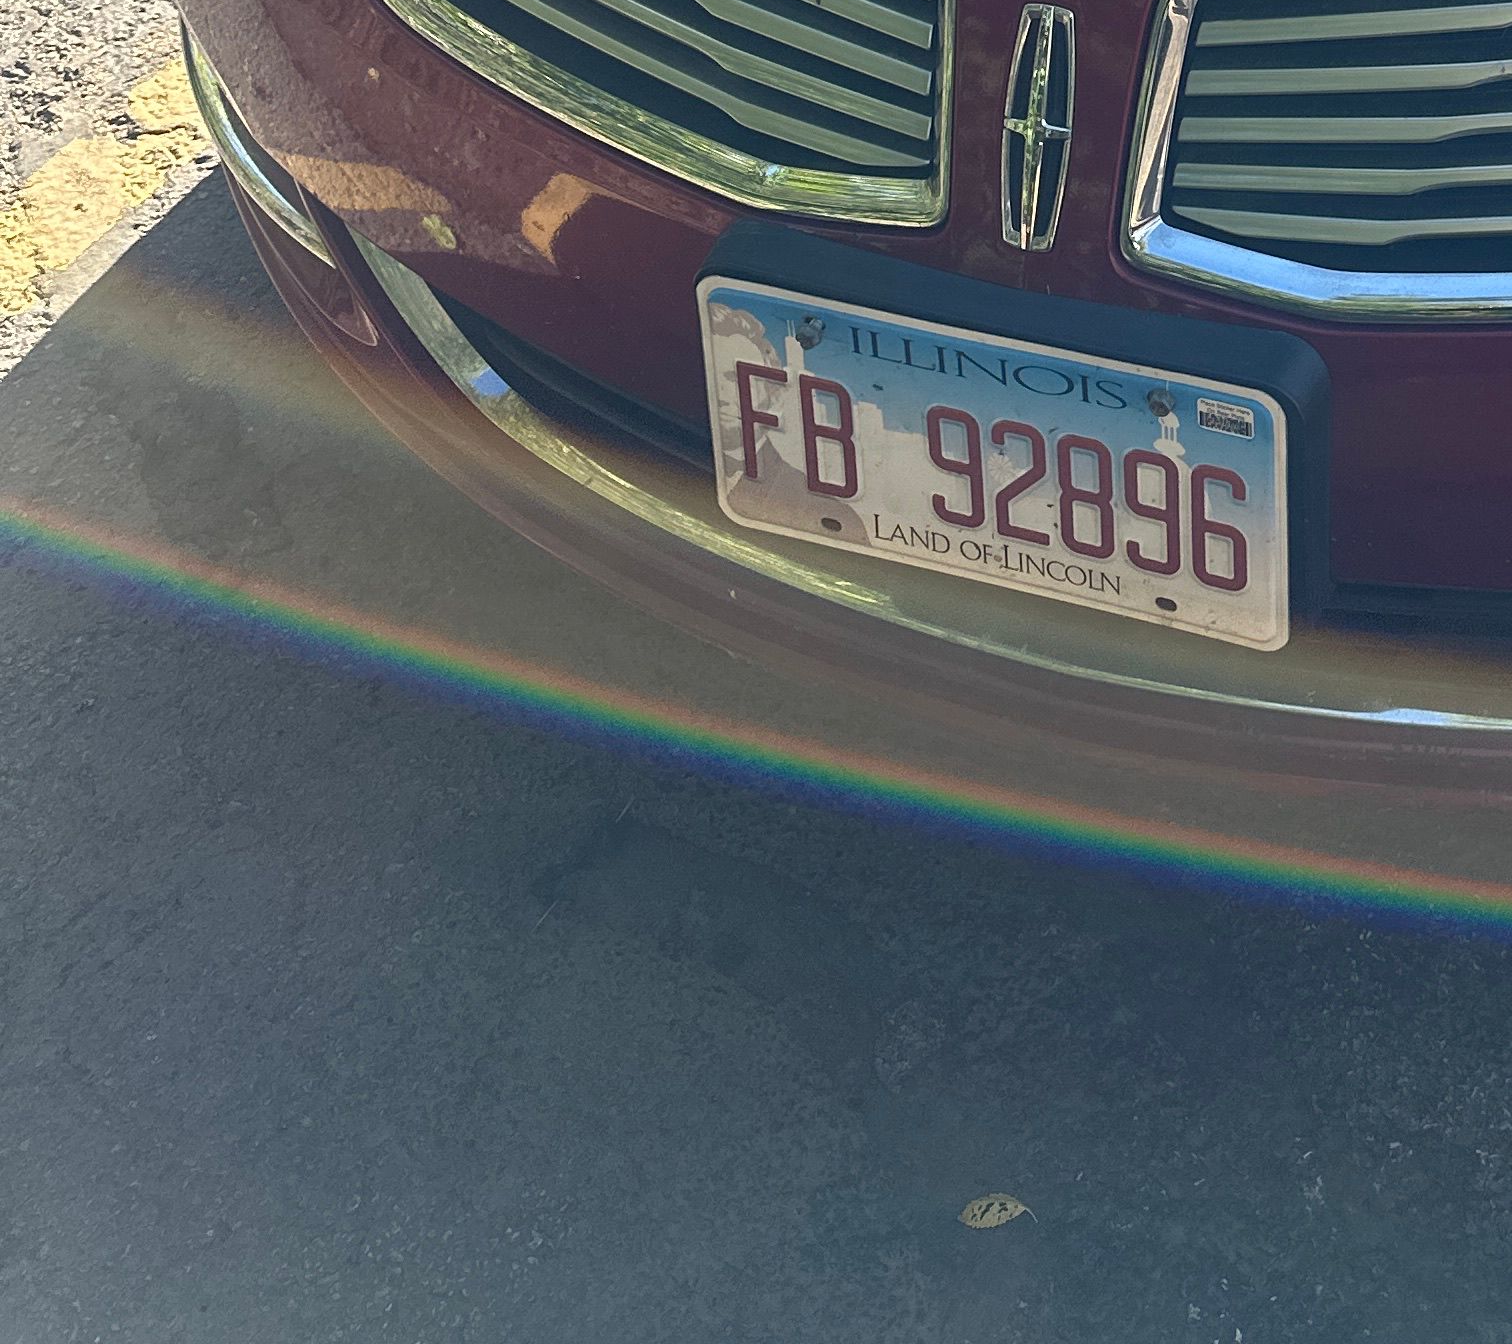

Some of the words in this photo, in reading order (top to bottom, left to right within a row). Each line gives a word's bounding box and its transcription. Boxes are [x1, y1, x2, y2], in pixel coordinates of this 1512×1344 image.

[848, 325, 1128, 411] ILLINOIS
[736, 360, 860, 500] FB
[926, 404, 1248, 592] 92896
